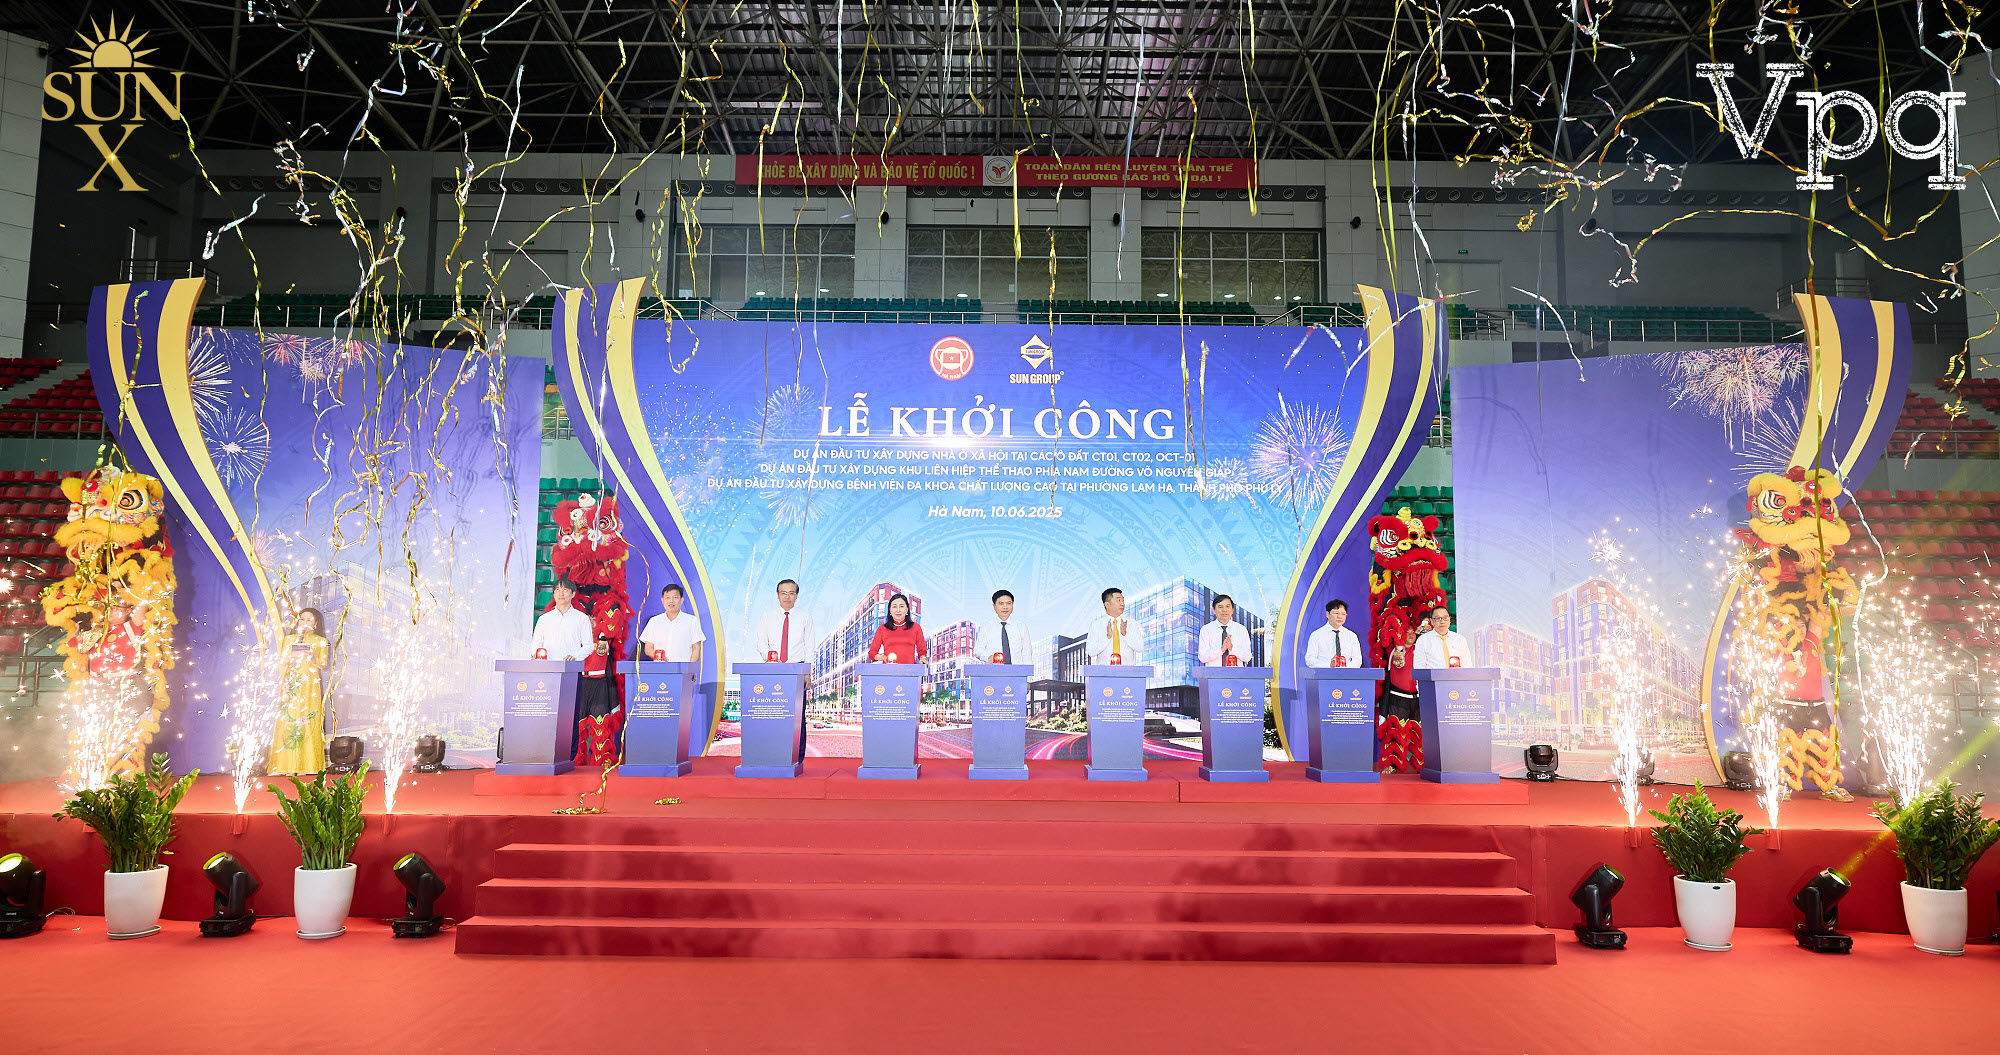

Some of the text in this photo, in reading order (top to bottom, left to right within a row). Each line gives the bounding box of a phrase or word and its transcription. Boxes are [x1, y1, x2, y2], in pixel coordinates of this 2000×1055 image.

[757, 161, 786, 178] HỎE
[806, 162, 827, 178] XÂY
[863, 162, 877, 179] VÀ
[905, 162, 919, 182] VỆ
[922, 160, 936, 179] TỔ
[938, 161, 968, 180] QUỐC
[1009, 374, 1030, 384] SUN
[819, 392, 1175, 439] LỄ KHỞI CÔNG
[793, 448, 810, 461] DỰ
[830, 446, 853, 459] ĐẦU
[855, 449, 871, 460] TƯ
[872, 446, 893, 460] XÂY
[896, 449, 930, 462] DỰNG
[971, 448, 986, 461] XÃ
[988, 449, 1009, 463] HỘI
[1011, 451, 1028, 464] TẠI
[1030, 449, 1054, 462] CÁC
[1068, 448, 1090, 462] ĐẤT
[1091, 452, 1120, 463] CT01,
[1122, 452, 1153, 463] CT02,
[1155, 452, 1196, 463] OCT-01
[760, 463, 777, 476] DỰ
[779, 461, 795, 474] ÁN
[797, 461, 820, 474] ĐẦU
[822, 464, 838, 474] TƯ
[839, 462, 861, 474] XÂY
[863, 464, 897, 477] DỰNG
[900, 466, 922, 475] KHU
[924, 464, 949, 475] LIÊN
[951, 464, 976, 478] HIỆP
[978, 462, 1000, 476] THỂ
[1002, 466, 1033, 476] THAO
[1035, 464, 1061, 476] PHÍA
[1063, 466, 1089, 476] NAM
[1092, 465, 1134, 477] ĐƯỜNG
[1136, 465, 1153, 477] VÕ
[707, 478, 724, 490] DỰ
[726, 476, 742, 488] ÁN
[745, 475, 767, 489] ĐẦU
[770, 479, 786, 489] TƯ
[787, 478, 809, 489] XÂY
[811, 479, 844, 491] DỰNG
[847, 478, 877, 492] BỆNH
[879, 478, 905, 492] VIỆN
[907, 481, 922, 490] ĐA
[925, 481, 956, 491] KHOA
[958, 478, 988, 491] CHẤT
[991, 480, 1031, 493] LƯỢNG
[1033, 482, 1058, 492] CAO
[1060, 482, 1077, 495] TẠI
[1079, 480, 1129, 493] PHƯỜNG
[1131, 483, 1155, 492] LAM
[1157, 483, 1176, 495] HẠ,
[928, 505, 1063, 519] Hà Nam, 10.06.2025
